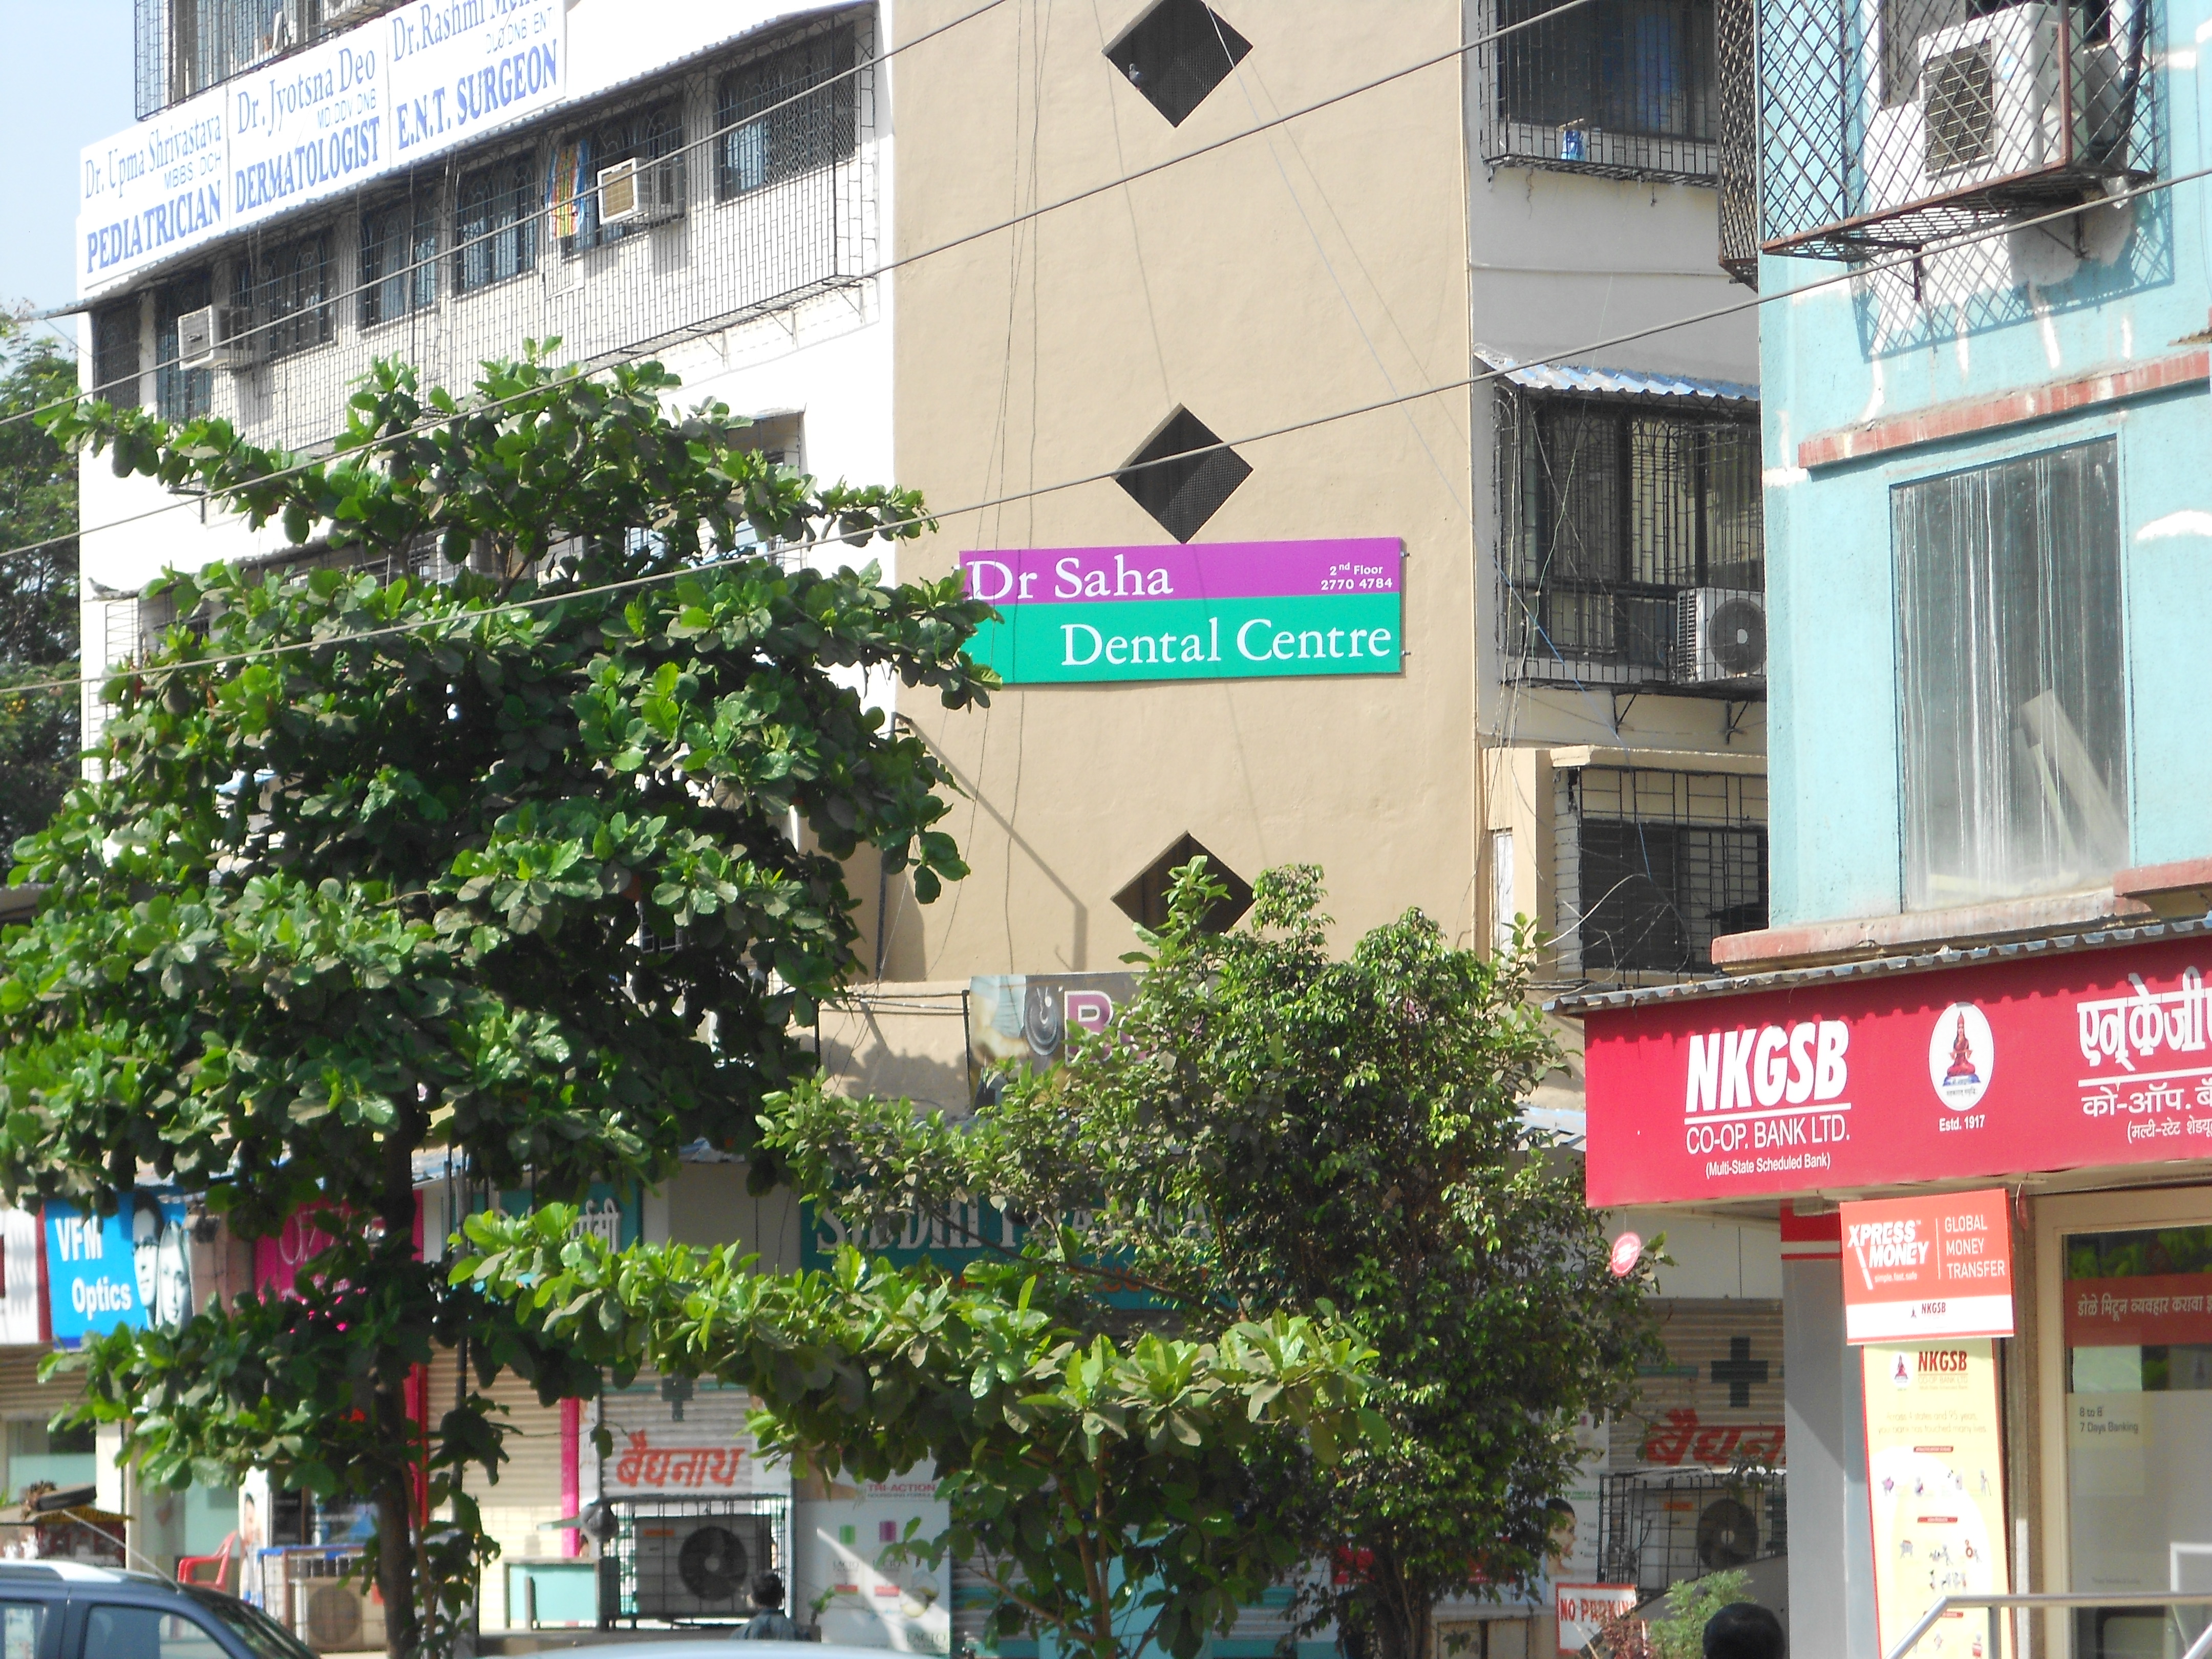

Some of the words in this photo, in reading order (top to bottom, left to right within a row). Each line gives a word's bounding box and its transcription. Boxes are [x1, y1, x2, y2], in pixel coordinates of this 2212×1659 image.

[338, 48, 375, 93] Deo
[396, 87, 451, 150] E.N.T.
[457, 38, 557, 125] SURGEON
[149, 115, 221, 172] Shrivastava
[200, 150, 221, 176] DCH
[236, 116, 379, 214] DERMATOLOGIST
[87, 180, 220, 274] PEDIATRICIAN
[966, 559, 1037, 600] Dr
[1055, 554, 1174, 599] Saha
[1330, 562, 1350, 576] 2nd
[1353, 565, 1383, 575] Floor
[1321, 579, 1354, 590] 2770
[1358, 578, 1393, 589] 4784
[1060, 617, 1221, 667] Dental
[1237, 618, 1392, 661] Centre
[1686, 1020, 1849, 1113] NKGSB
[1686, 1123, 1749, 1154] CO-OP.
[1754, 1117, 1806, 1148] BANK
[1812, 1114, 1851, 1143] LTD.
[1939, 1117, 1962, 1132] Estd.
[1964, 1114, 1986, 1130] 1917
[1706, 1159, 1754, 1180] (Multi-State
[1756, 1154, 1802, 1173] Scheduled
[1804, 1152, 1832, 1171] Bank)
[1847, 1220, 1916, 1247] XPRESS
[1945, 1214, 1988, 1232] GLOBAL
[55, 1215, 102, 1262] VFM
[1946, 1238, 1985, 1256] MONEY
[1869, 1241, 1929, 1268] MONEY
[1947, 1260, 2005, 1279] TRANSFER
[72, 1276, 132, 1321] Optics
[1922, 1302, 1946, 1314] NKGSB
[1918, 1351, 1967, 1372] NKGSB
[1934, 1410, 1947, 1420] and
[2080, 1422, 2085, 1432] 7
[2088, 1422, 2106, 1434] Days
[2108, 1421, 2138, 1434] Banking
[1561, 1599, 1575, 1621] NO
